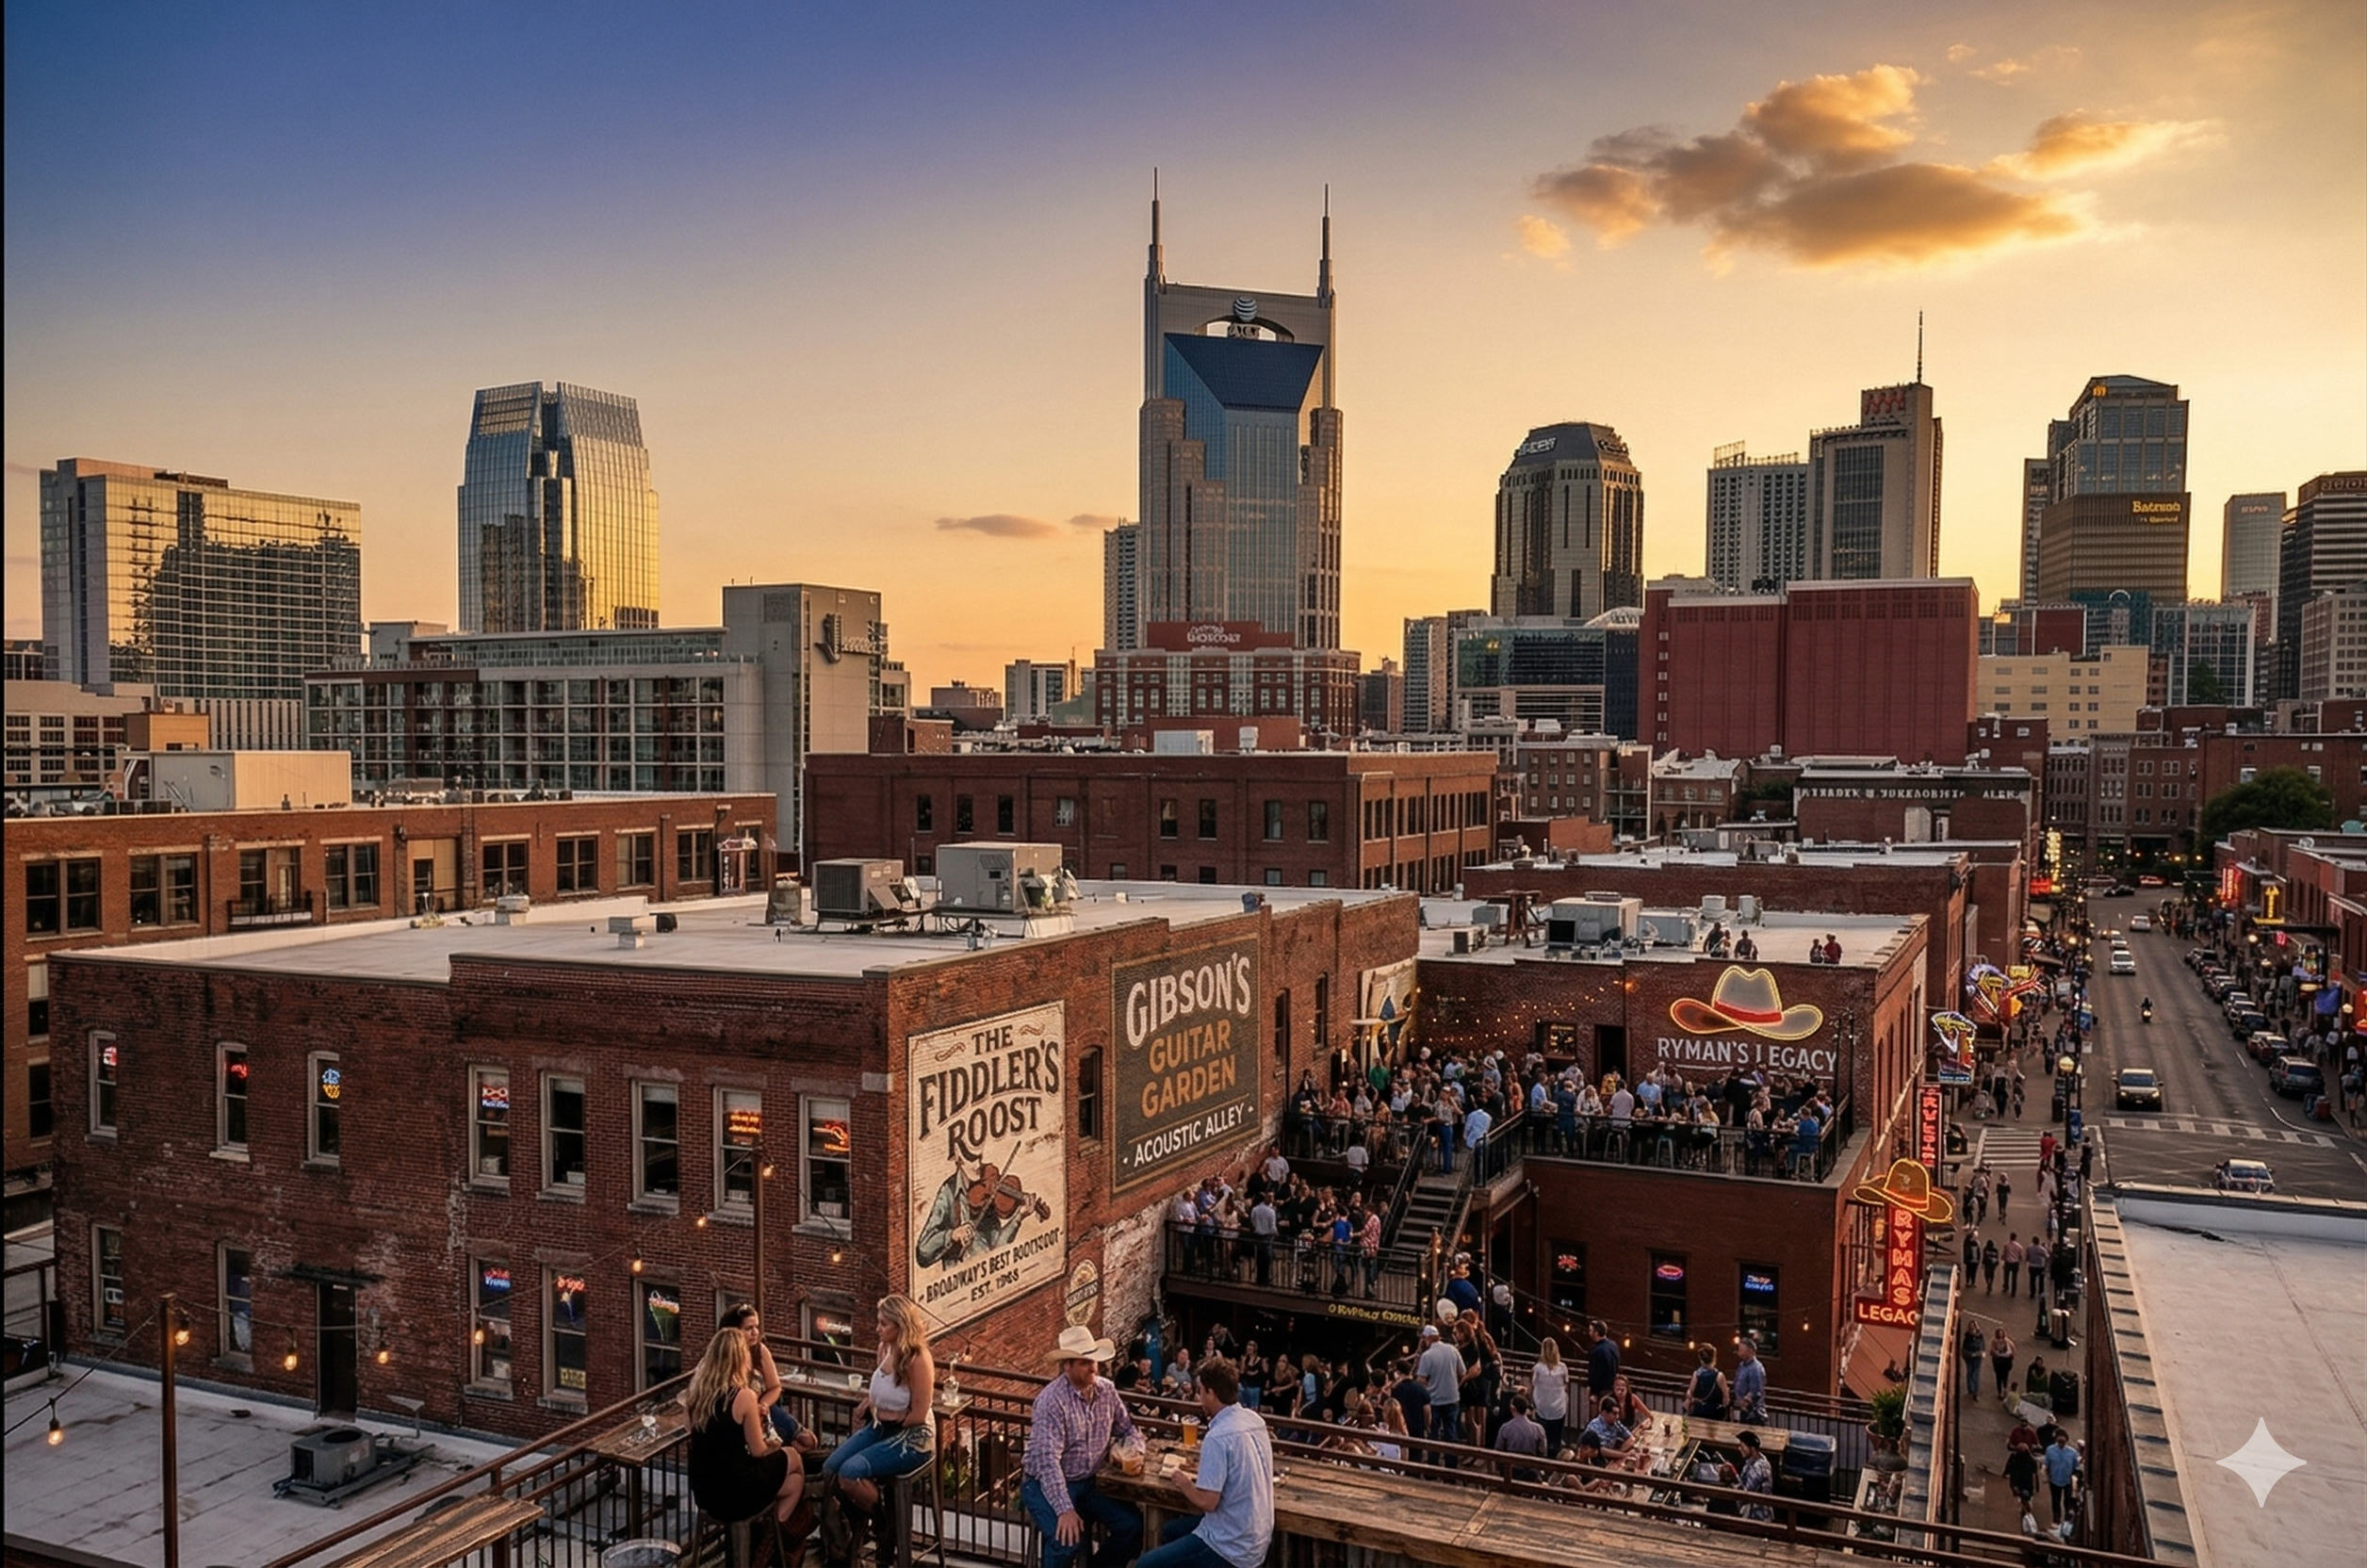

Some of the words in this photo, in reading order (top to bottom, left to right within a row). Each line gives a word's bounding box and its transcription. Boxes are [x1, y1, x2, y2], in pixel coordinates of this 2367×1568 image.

[1126, 952, 1251, 1048] GIBSON'S
[971, 1025, 1013, 1055] THE
[1149, 1019, 1232, 1074] GUITAR
[1657, 1037, 1749, 1065] RYMAN'S
[919, 1039, 1060, 1140] FIDDLER'S
[1141, 1054, 1236, 1119] GARDEN
[947, 1097, 1041, 1163] ROOST
[1134, 1120, 1202, 1168] ACOUSTIC
[1204, 1102, 1245, 1140] ALLEY
[989, 1250, 1011, 1275] BEST
